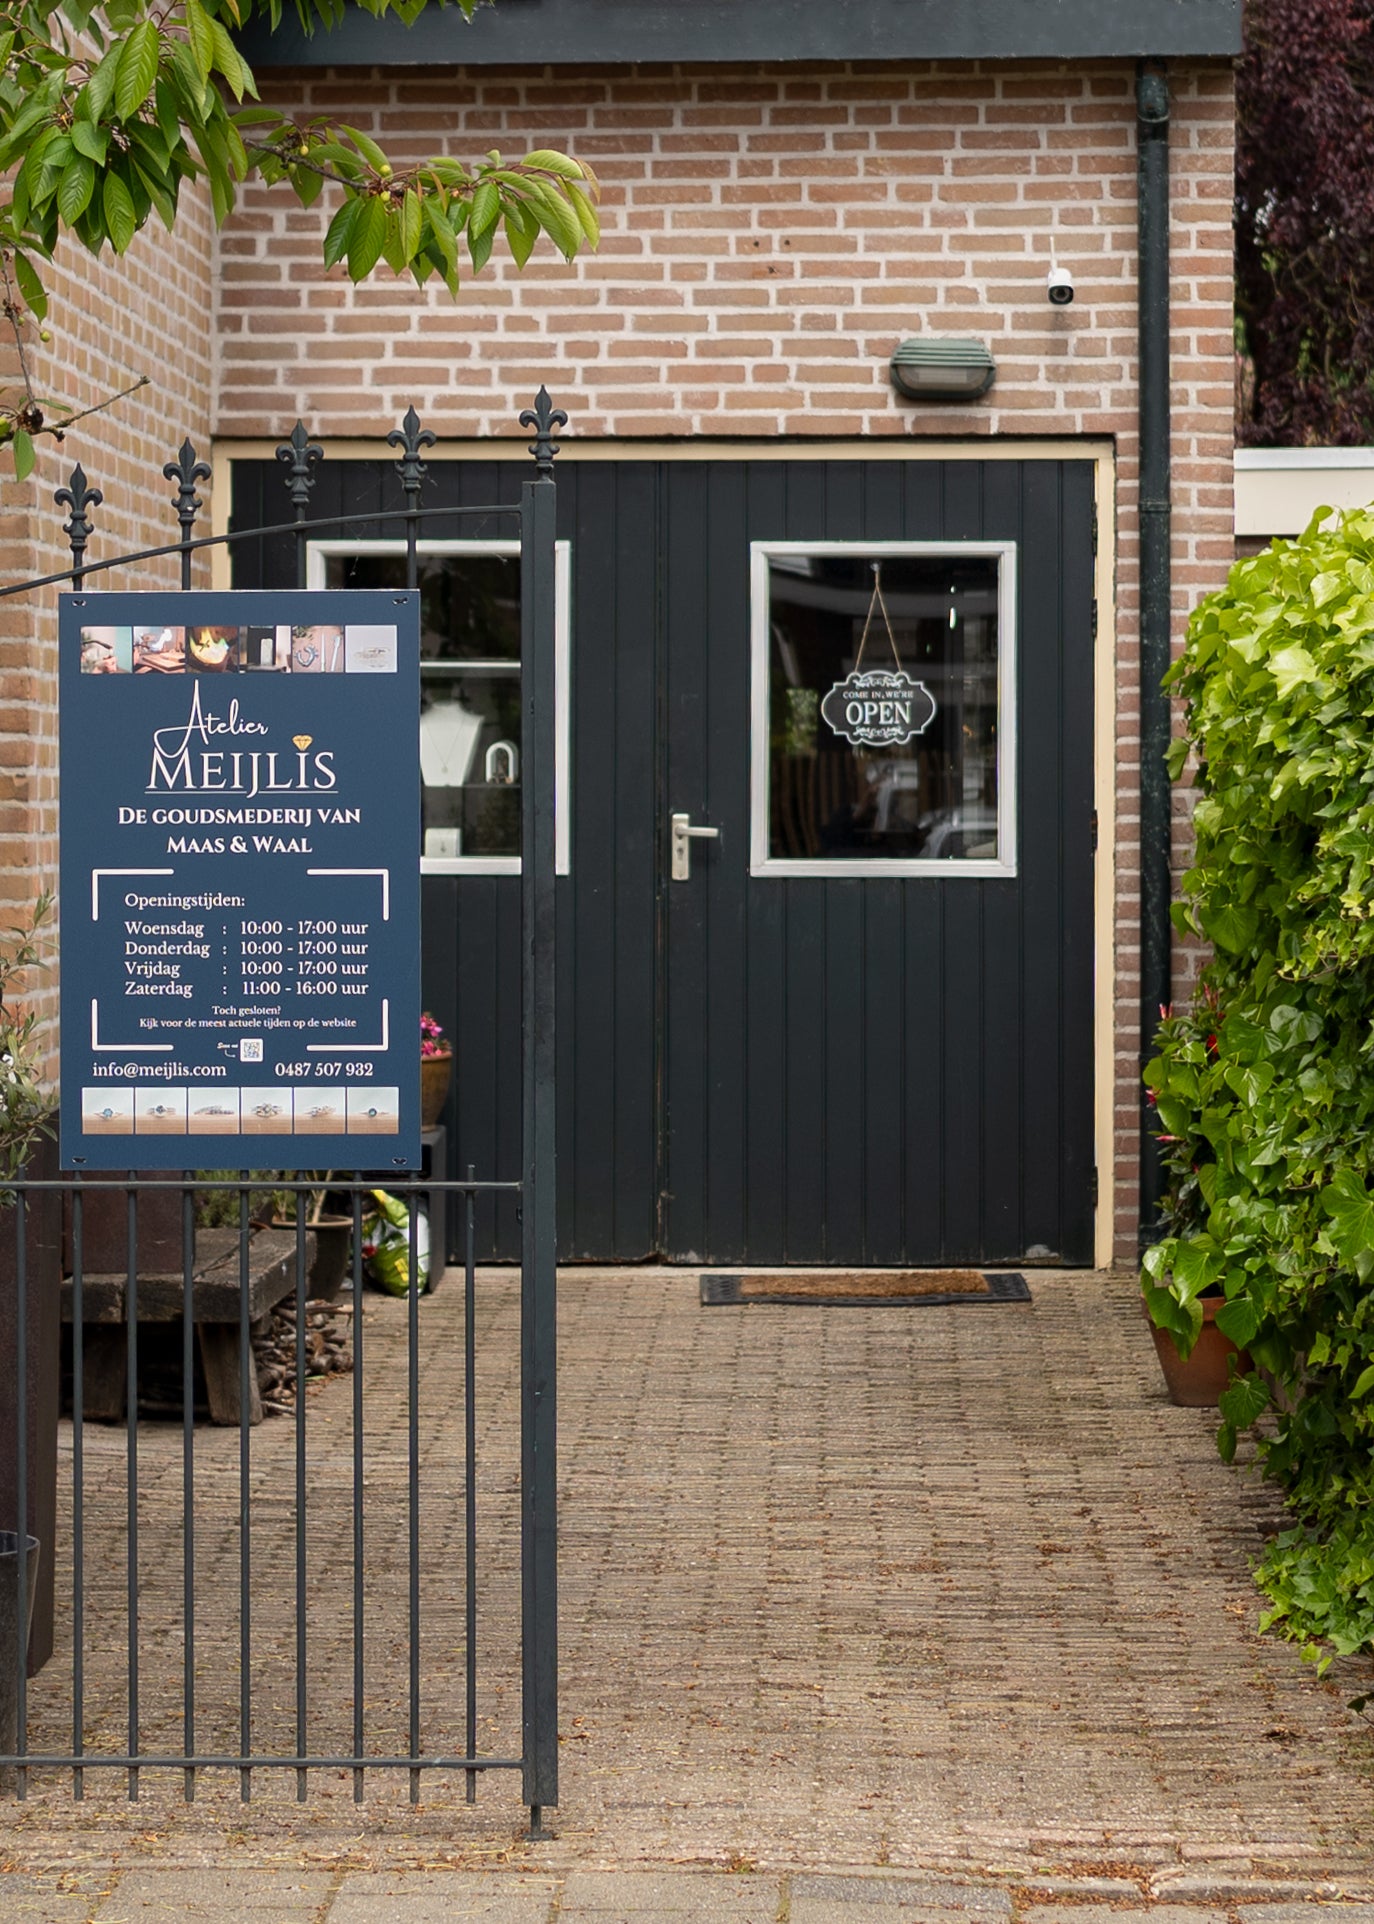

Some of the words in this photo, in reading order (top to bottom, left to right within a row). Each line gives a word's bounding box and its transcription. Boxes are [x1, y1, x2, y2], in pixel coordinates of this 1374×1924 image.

[842, 691, 869, 699] COME
[153, 679, 268, 758] Atelier
[845, 701, 911, 725] OPEN
[229, 835, 249, 854] &
[124, 892, 245, 911] Openingstijden:
[124, 920, 205, 939] Woensdag
[241, 920, 283, 935] 10:00
[298, 920, 338, 935] 17:00
[340, 923, 369, 935] uur
[125, 940, 211, 959] Donderdag
[241, 940, 283, 955] 10:00
[298, 940, 338, 955] 17:00
[341, 944, 369, 955] uur
[124, 960, 181, 979] Vrijdag
[241, 960, 283, 975] 10:00
[298, 960, 338, 975] 17:00
[341, 964, 369, 975] uur
[124, 980, 194, 999] Zaterdag
[243, 980, 281, 995] 11:00
[296, 980, 338, 995] 16:00
[341, 984, 369, 995] uur
[211, 1005, 237, 1016] Toch
[238, 1005, 282, 1018] gesloten?
[139, 1017, 159, 1030] Kijk
[160, 1020, 184, 1028] voor
[184, 1017, 197, 1028] de
[198, 1019, 227, 1028] meest
[228, 1017, 262, 1028] actuele
[263, 1017, 291, 1030] tijden
[292, 1019, 306, 1030] op
[306, 1017, 320, 1028] de
[321, 1017, 357, 1028] website
[92, 1061, 227, 1081] info@meijlis.com
[274, 1061, 312, 1077] 0487
[314, 1061, 343, 1077] 507
[345, 1062, 374, 1077] 932
